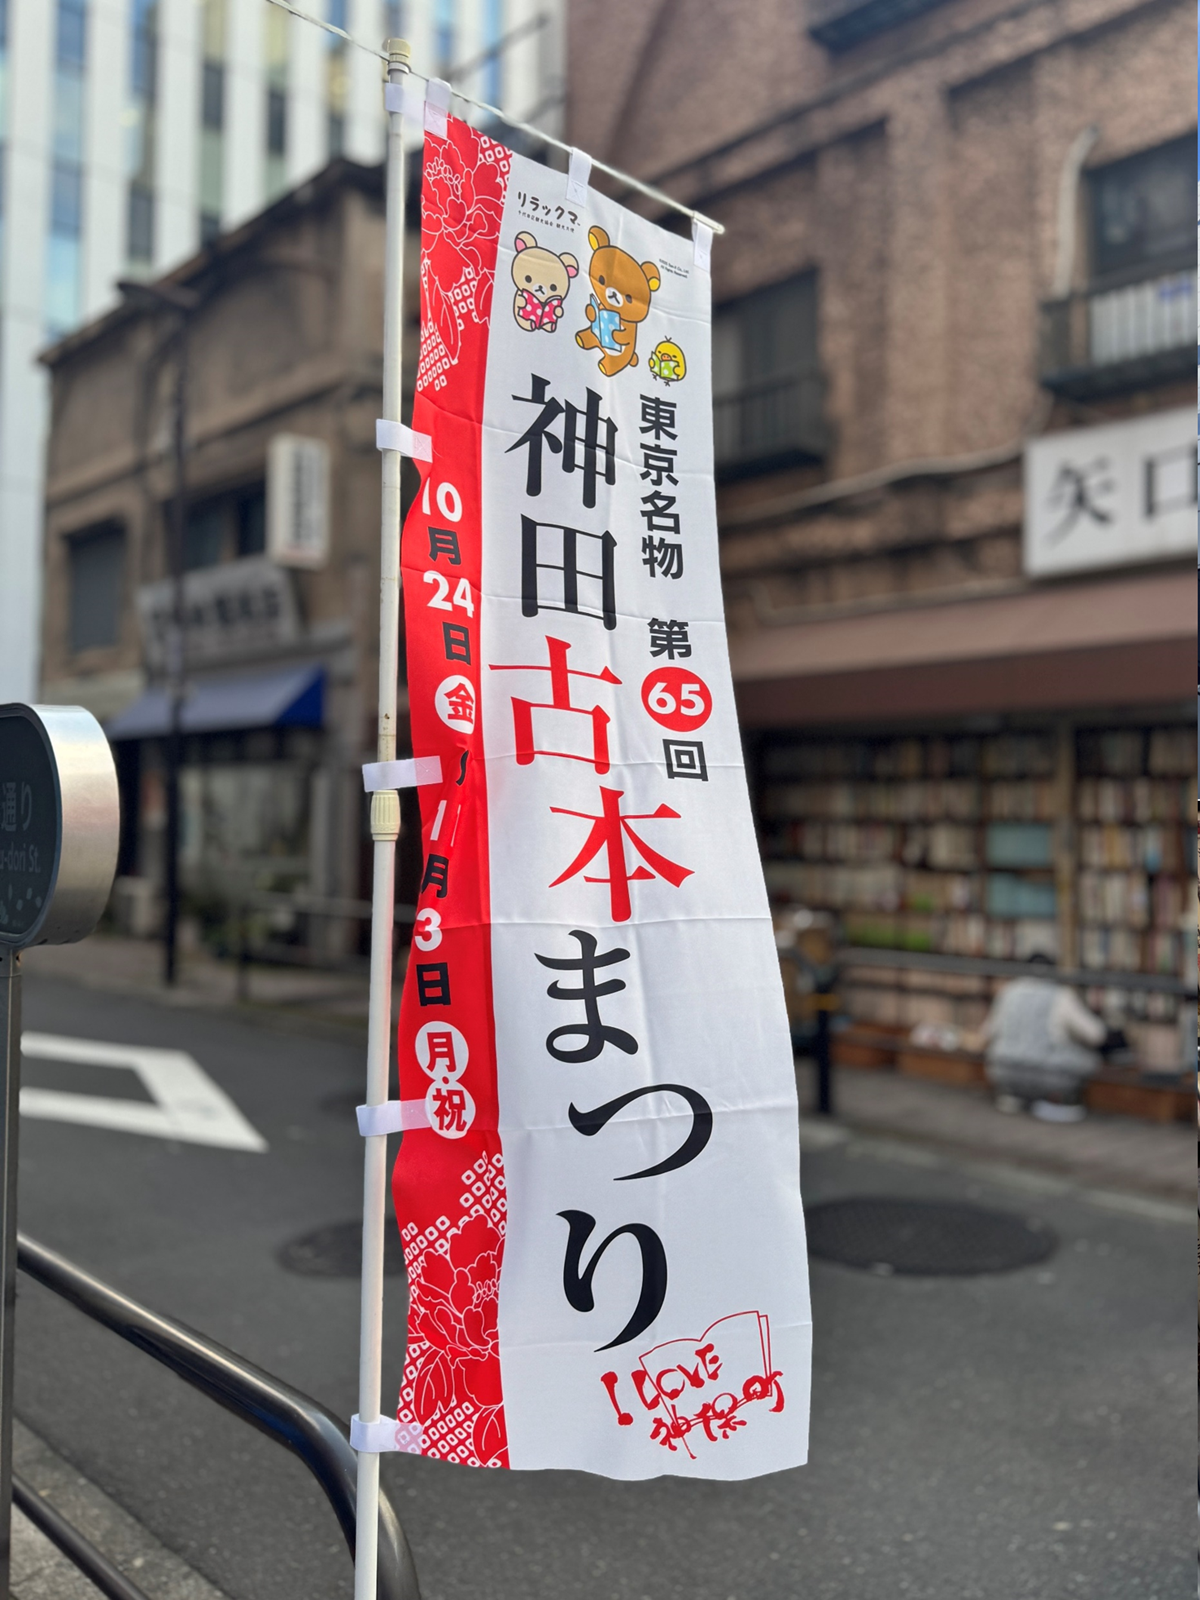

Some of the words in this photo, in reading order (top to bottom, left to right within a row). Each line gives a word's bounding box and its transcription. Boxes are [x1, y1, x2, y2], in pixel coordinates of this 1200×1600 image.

[517, 191, 579, 225] リラックマ
[639, 394, 684, 580] 東京名物
[644, 617, 710, 782] 第65回
[28, 844, 41, 873] St.
[505, 373, 713, 1353] 神田古本まつり
[630, 1343, 723, 1411] LOVE
